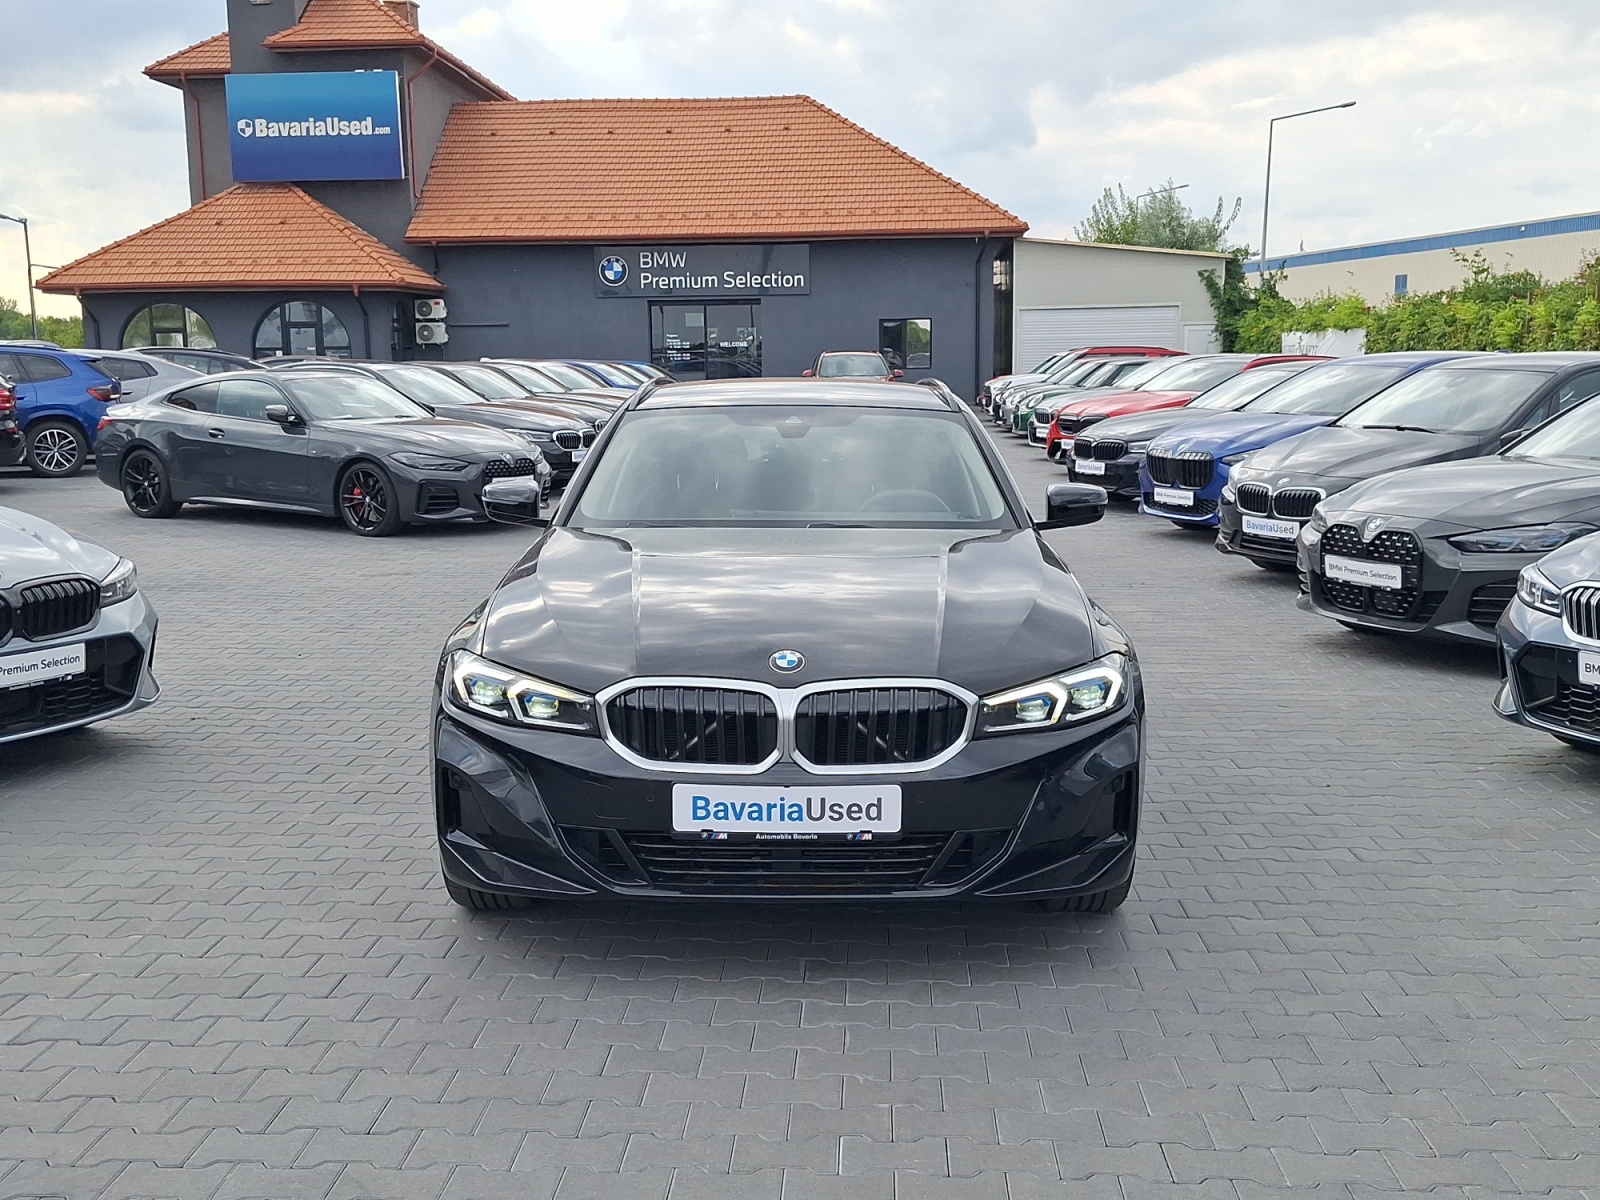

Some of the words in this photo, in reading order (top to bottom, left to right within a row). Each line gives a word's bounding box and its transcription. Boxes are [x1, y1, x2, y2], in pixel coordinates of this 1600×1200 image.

[639, 251, 687, 268] BMW
[640, 272, 718, 289] Premium
[723, 270, 805, 288] Selection
[1246, 519, 1294, 535] BavariaUsed
[1328, 563, 1343, 572] BMW
[1343, 565, 1369, 577] Premium
[1369, 570, 1397, 581] Selection
[41, 654, 81, 669] Selection
[691, 795, 883, 822] BavariaUsed
